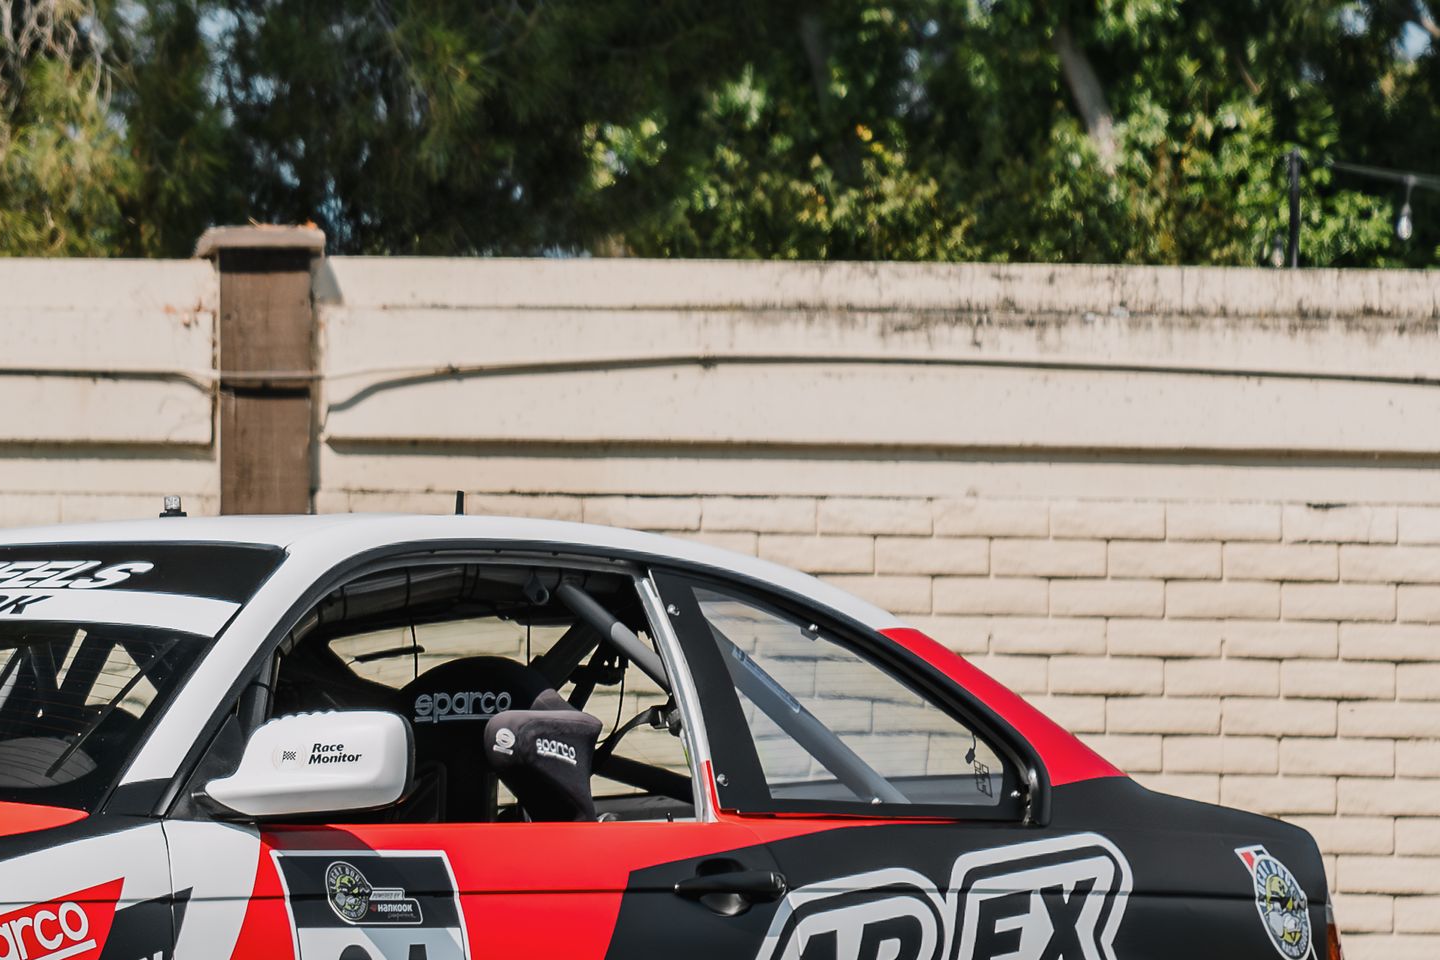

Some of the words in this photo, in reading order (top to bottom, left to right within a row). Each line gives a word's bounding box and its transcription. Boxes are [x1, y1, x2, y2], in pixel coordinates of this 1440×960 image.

[415, 691, 512, 724] sparco
[312, 743, 344, 753] Race
[536, 738, 577, 760] sparco
[308, 753, 362, 764] Monitor
